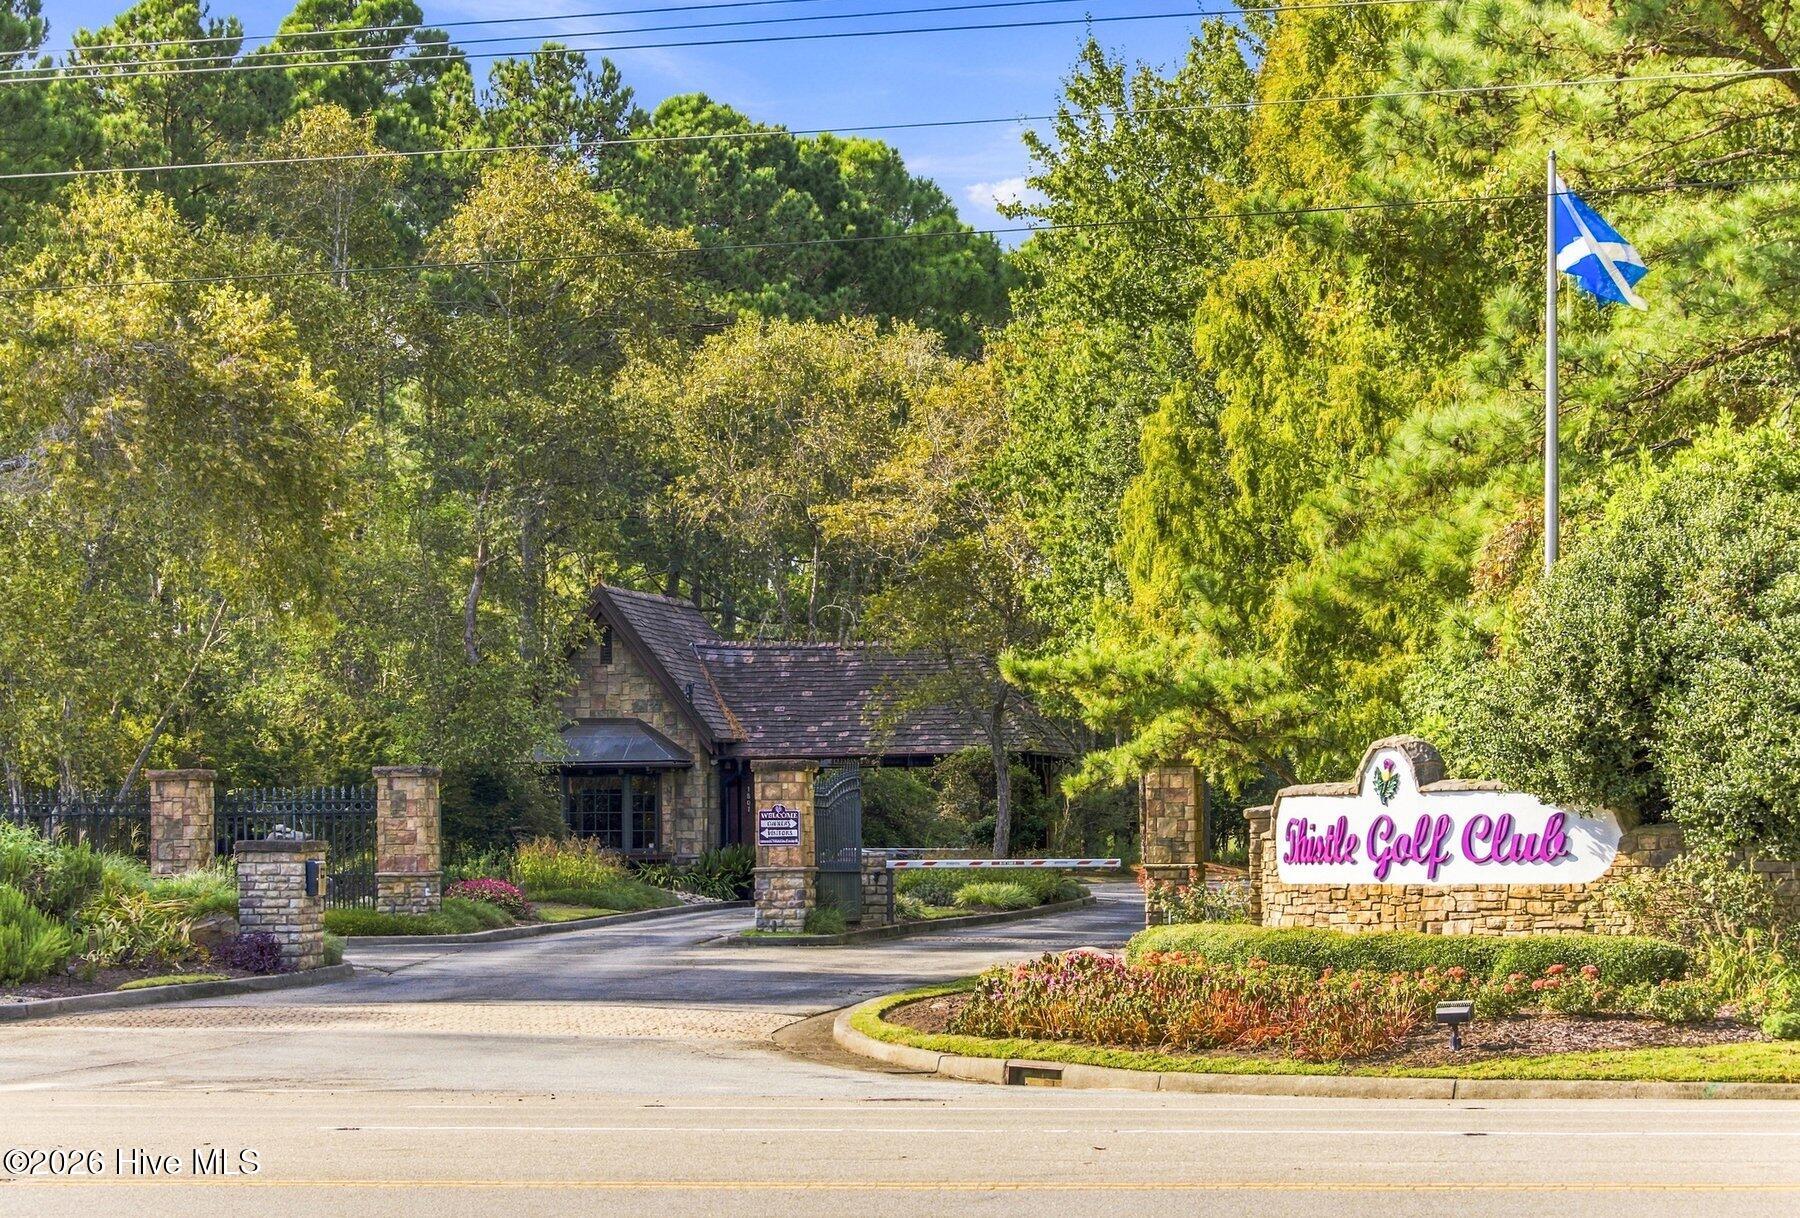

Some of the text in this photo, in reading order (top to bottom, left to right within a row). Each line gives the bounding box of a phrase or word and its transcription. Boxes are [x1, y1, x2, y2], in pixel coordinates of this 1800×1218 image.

[1283, 812, 1570, 881] Thistle Golf Club
